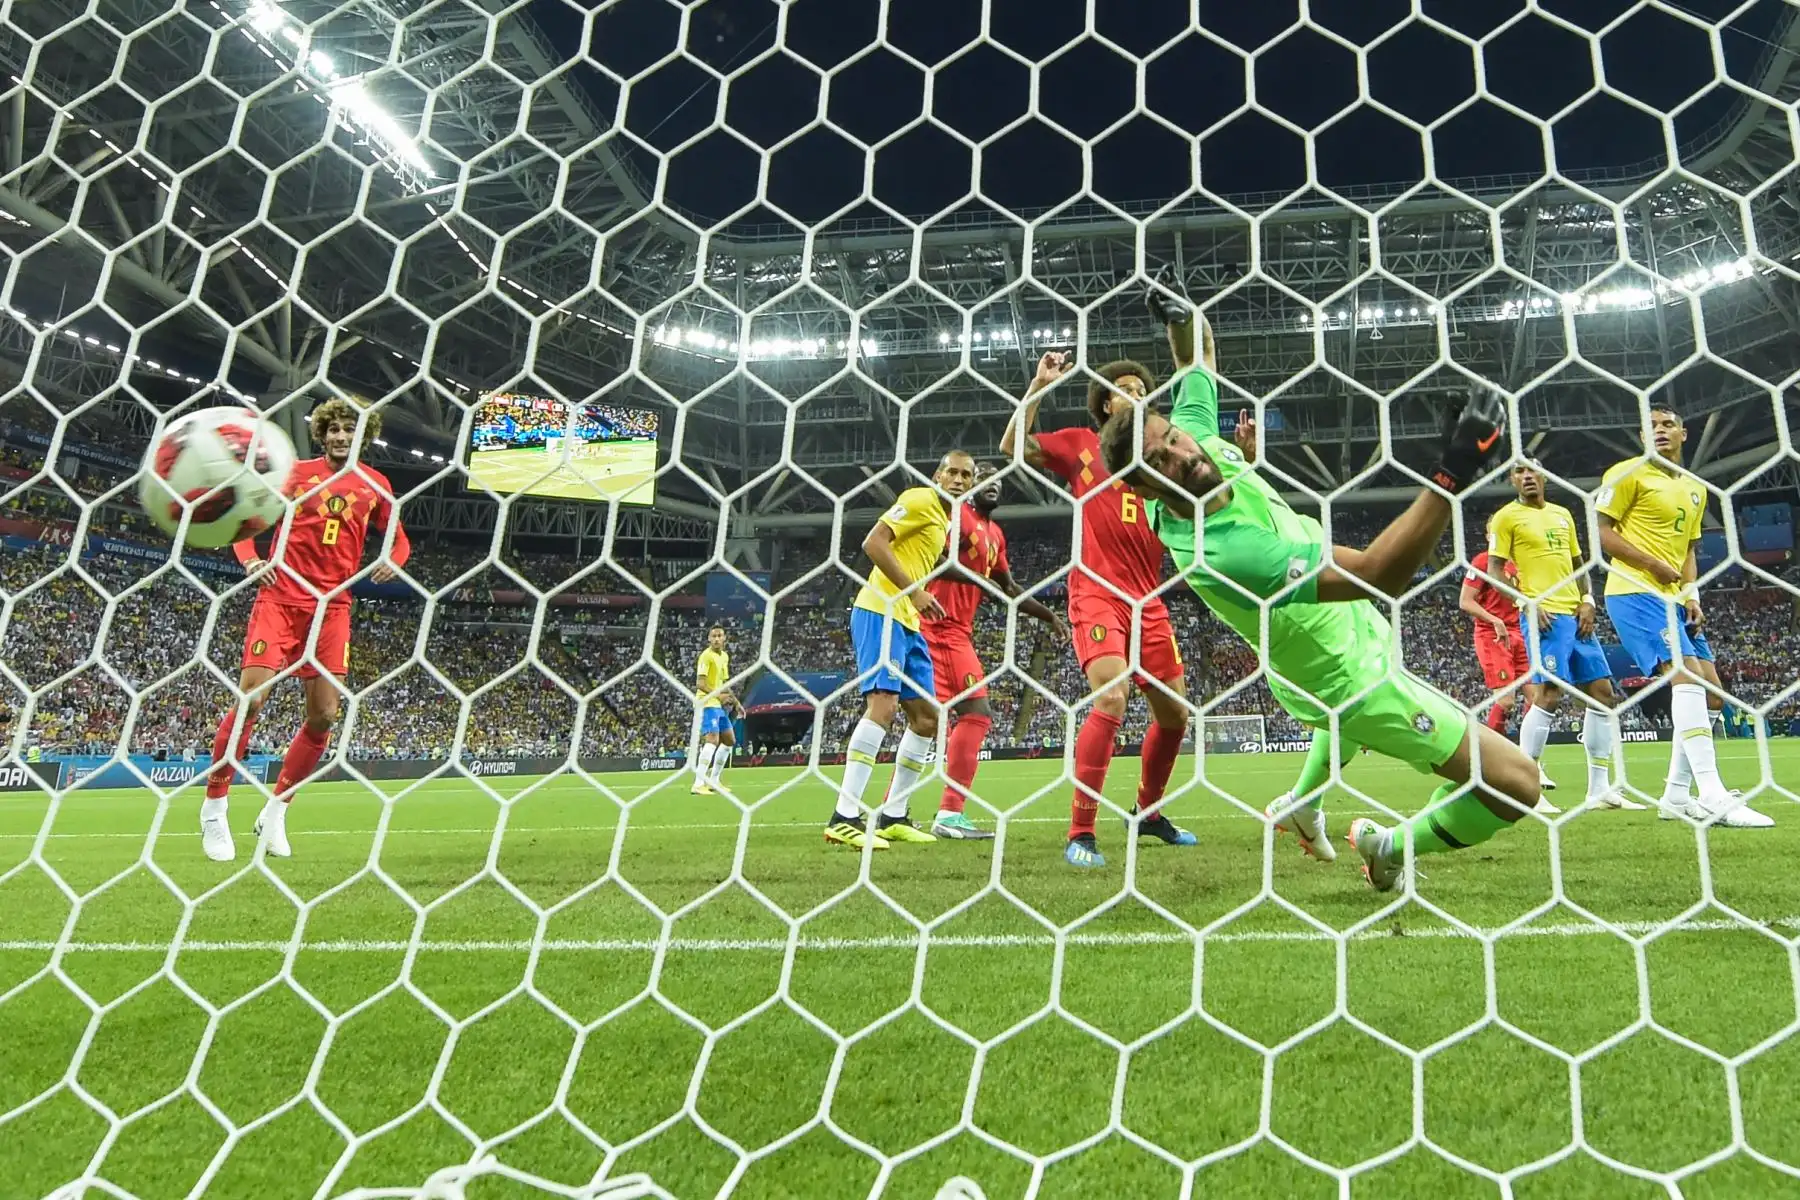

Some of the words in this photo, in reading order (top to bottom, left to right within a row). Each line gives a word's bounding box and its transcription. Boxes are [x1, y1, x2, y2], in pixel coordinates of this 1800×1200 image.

[1121, 491, 1138, 524] 6
[1674, 507, 1686, 533] 2
[322, 518, 340, 545] 8
[1620, 730, 1658, 741] UNDAI
[1265, 741, 1313, 752] HYUNDA
[483, 761, 517, 774] HYUNDAI
[650, 759, 676, 769] HYUNDAI
[150, 766, 195, 783] KAZAN
